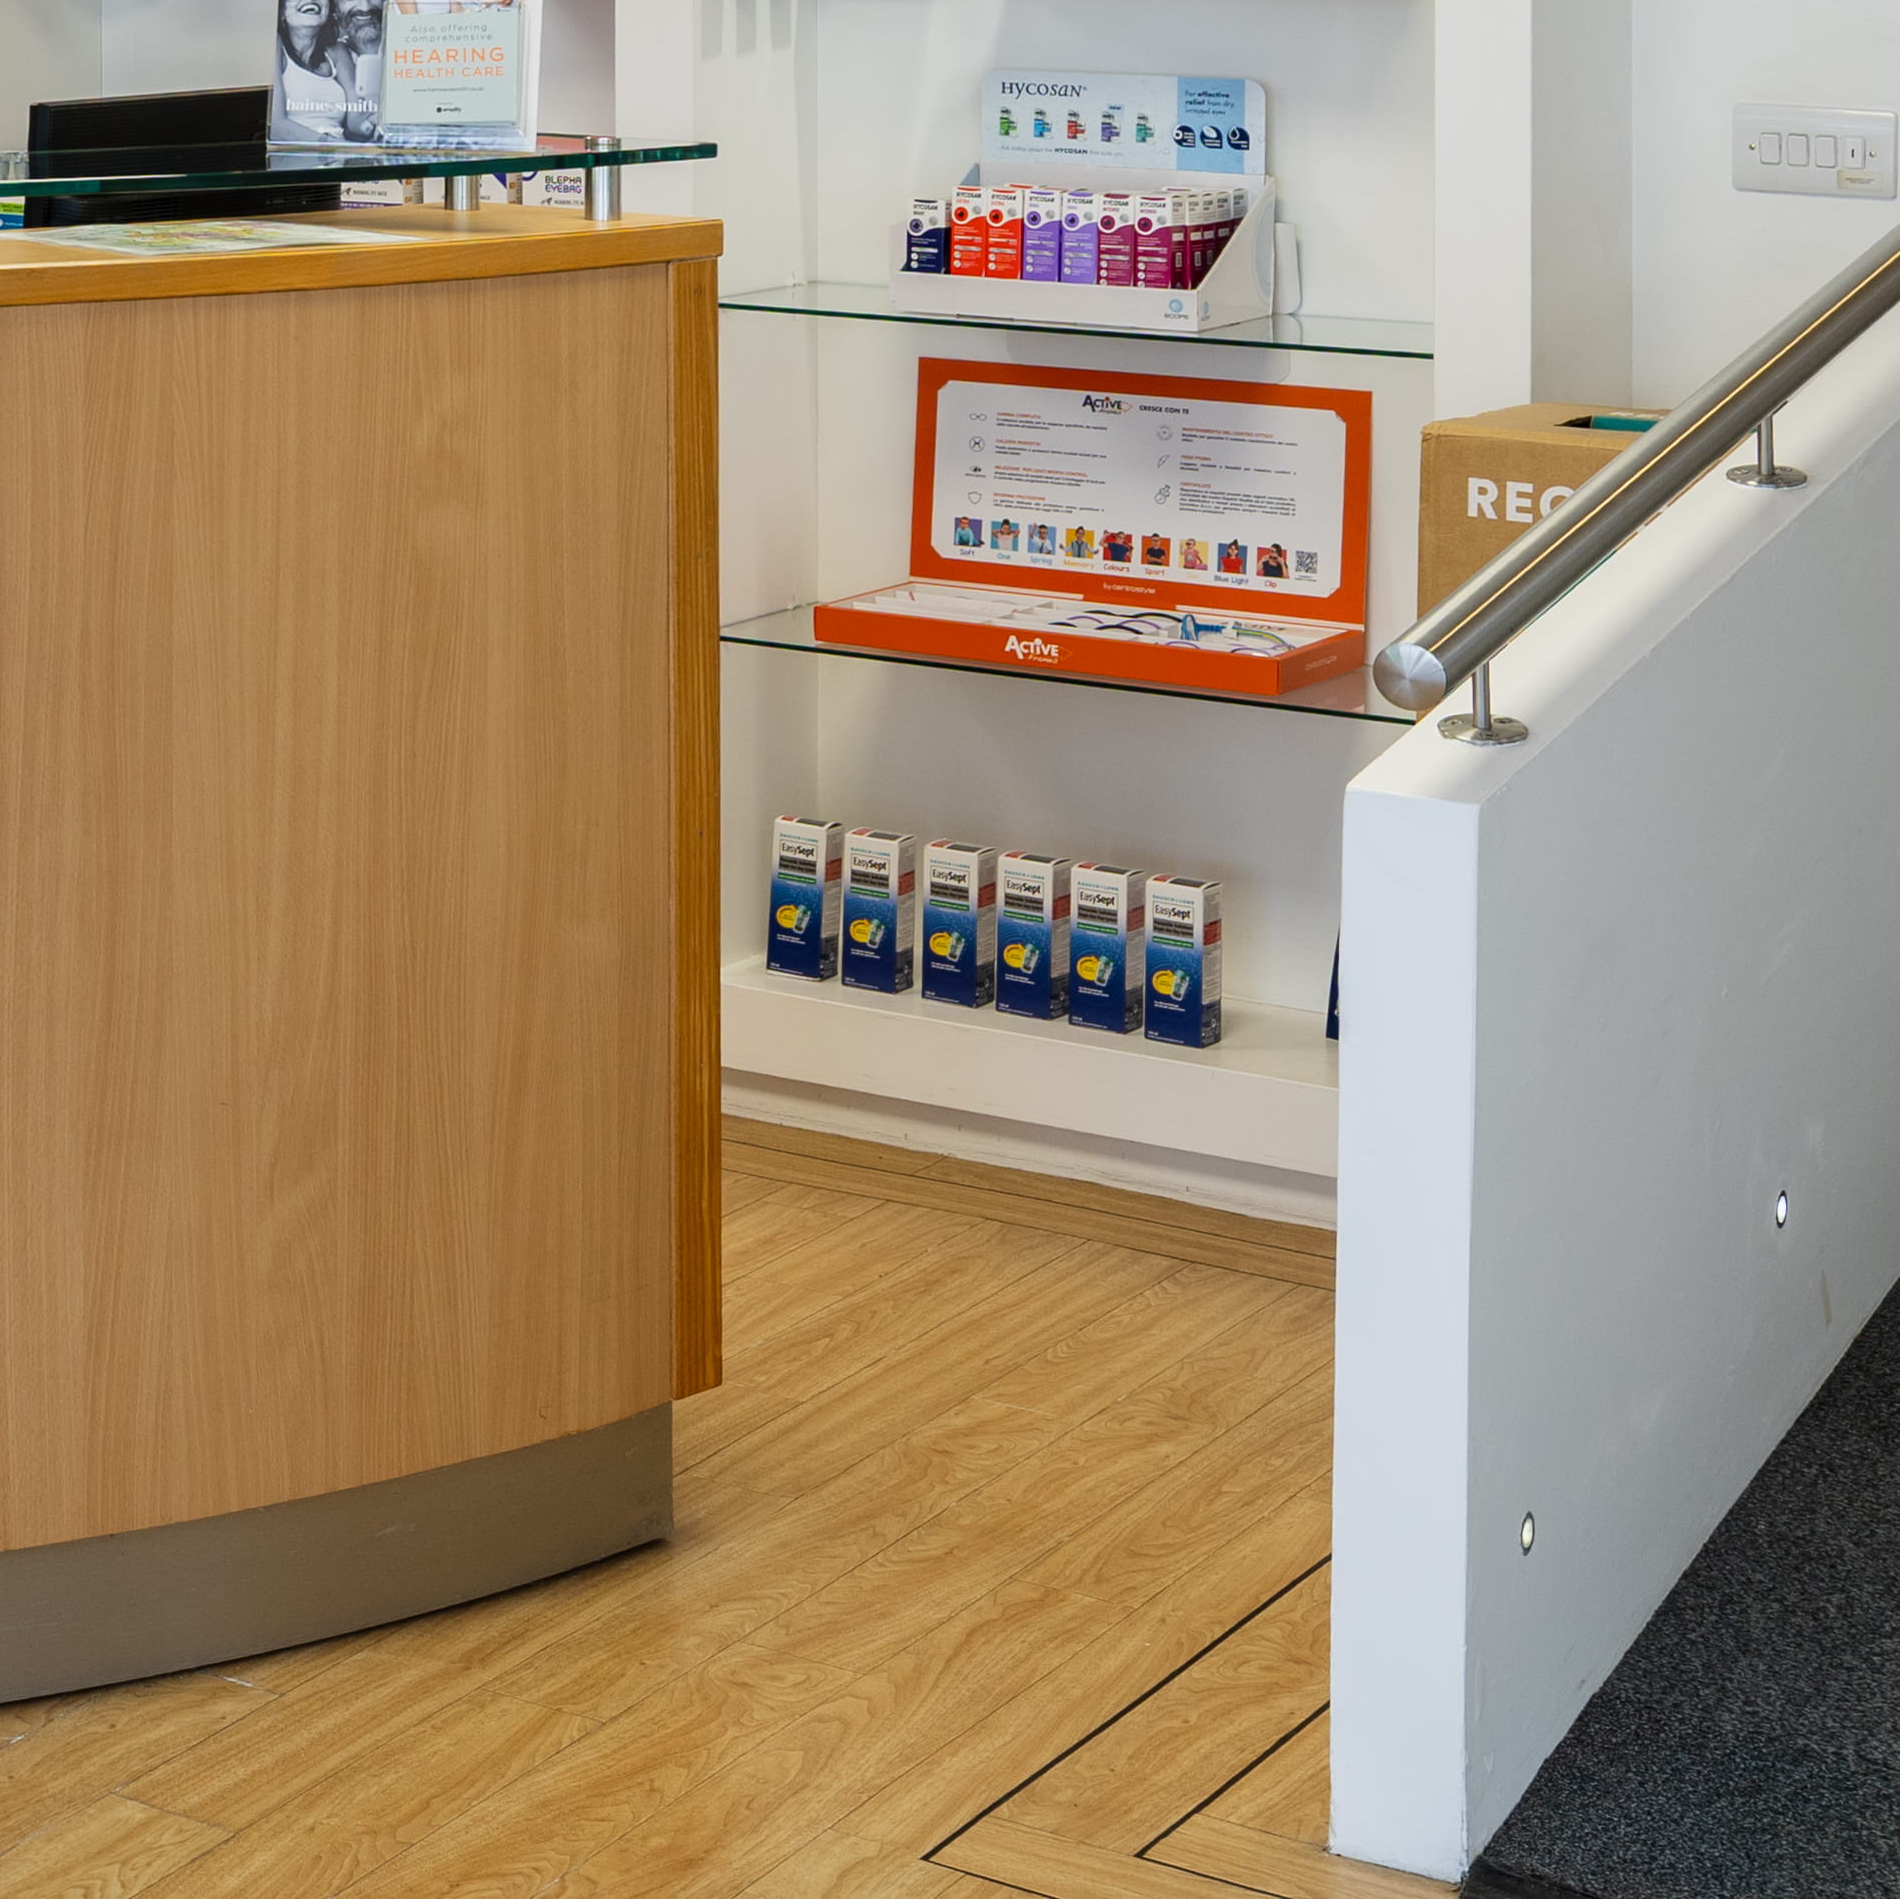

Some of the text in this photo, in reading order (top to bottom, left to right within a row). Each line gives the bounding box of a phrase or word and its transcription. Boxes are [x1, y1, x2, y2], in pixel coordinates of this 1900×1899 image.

[410, 23, 488, 34] Also offering
[404, 33, 493, 44] comprehensive
[393, 46, 505, 65] HEARING
[393, 66, 505, 79] HEALTH CARE
[1000, 81, 1083, 100] HYCOSAN
[1197, 90, 1231, 99] effective
[544, 175, 583, 184] BLEPHA
[544, 184, 583, 194] EYEBAG
[959, 547, 976, 558] Soft
[996, 551, 1012, 562] One
[1029, 553, 1054, 568] Spring
[1062, 557, 1096, 571] Memory
[1102, 561, 1131, 574] Colours
[1144, 567, 1167, 579] Sport
[1212, 574, 1250, 587] Blue Light
[781, 842, 816, 858] EasySept
[852, 856, 887, 872] EasySept
[932, 868, 967, 884] EasySept
[1006, 880, 1042, 896] EasySept
[1079, 890, 1116, 907] EasySept
[1154, 904, 1191, 920] EasySept
